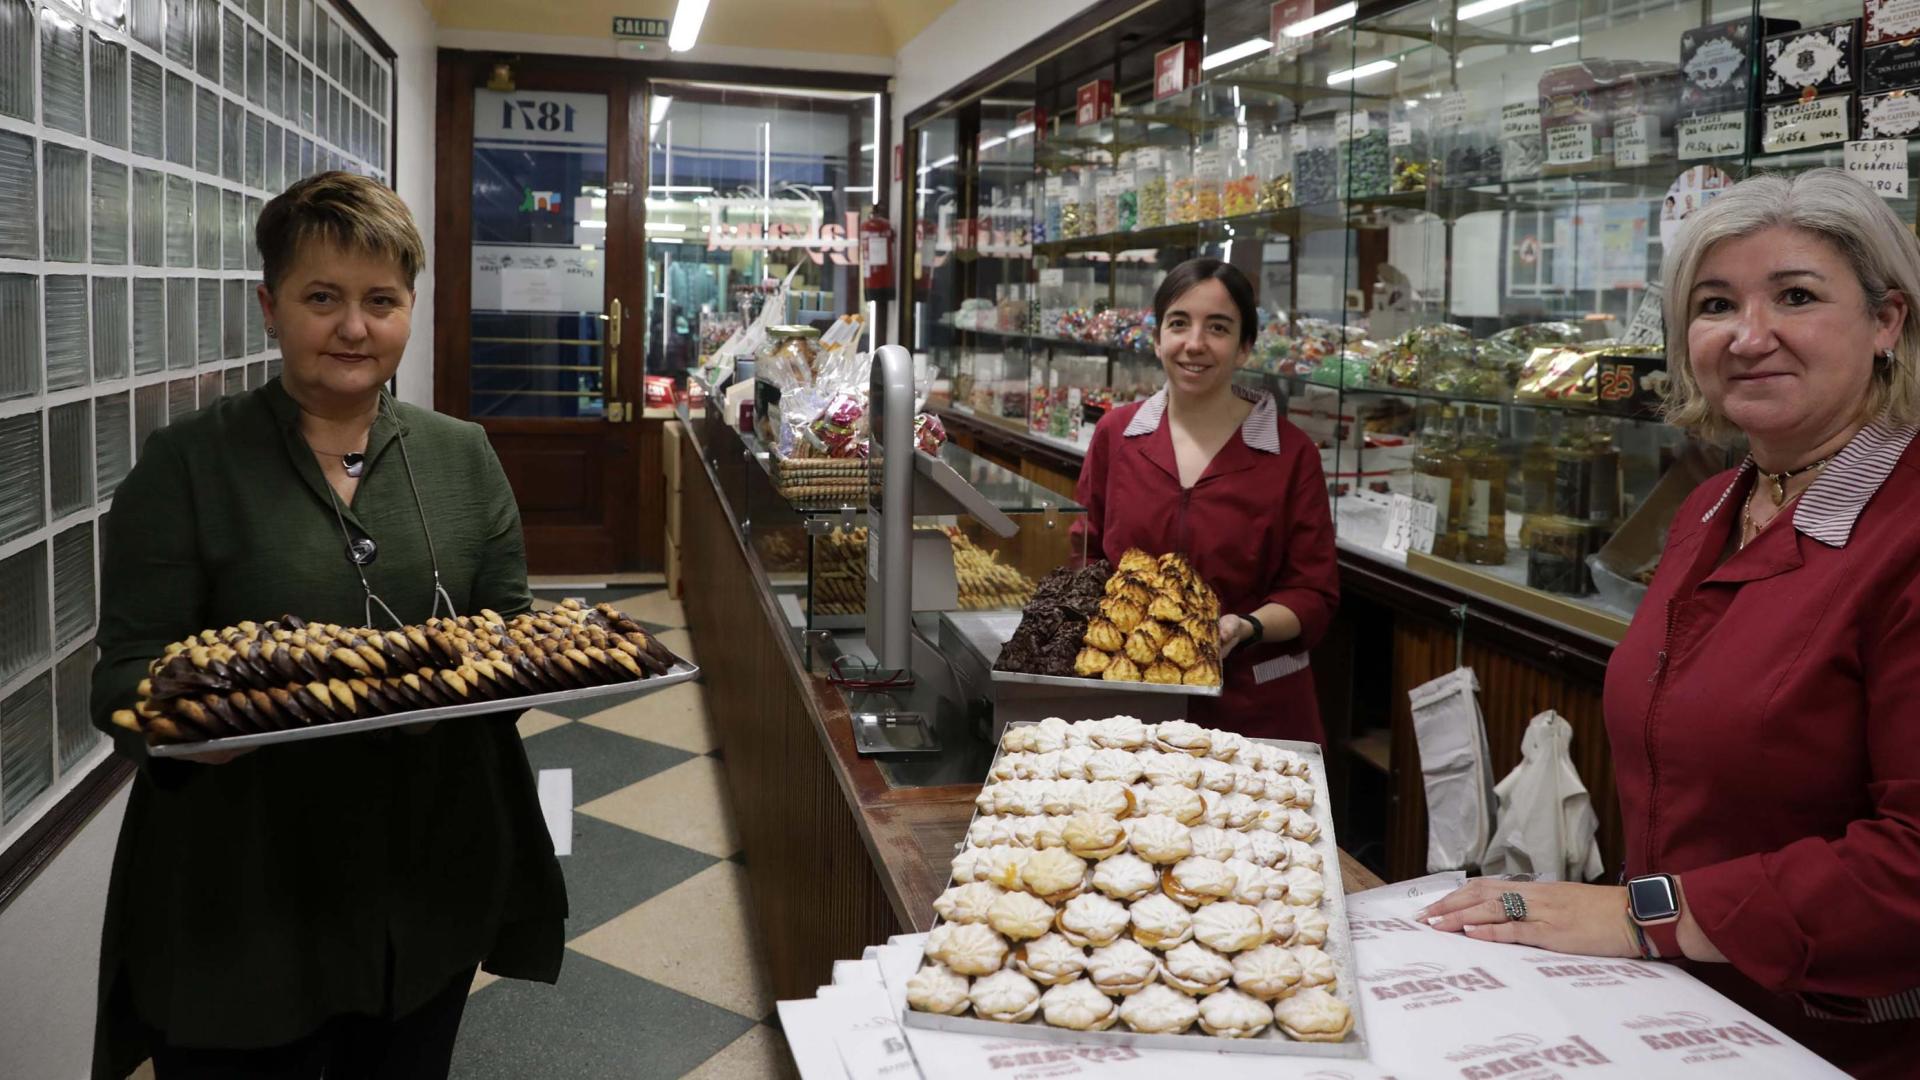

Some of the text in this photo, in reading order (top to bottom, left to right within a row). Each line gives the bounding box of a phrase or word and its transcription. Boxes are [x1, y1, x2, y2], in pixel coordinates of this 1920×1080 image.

[615, 19, 666, 35] SALIDA
[1850, 142, 1895, 151] TEJAS
[1601, 365, 1635, 394] 25
